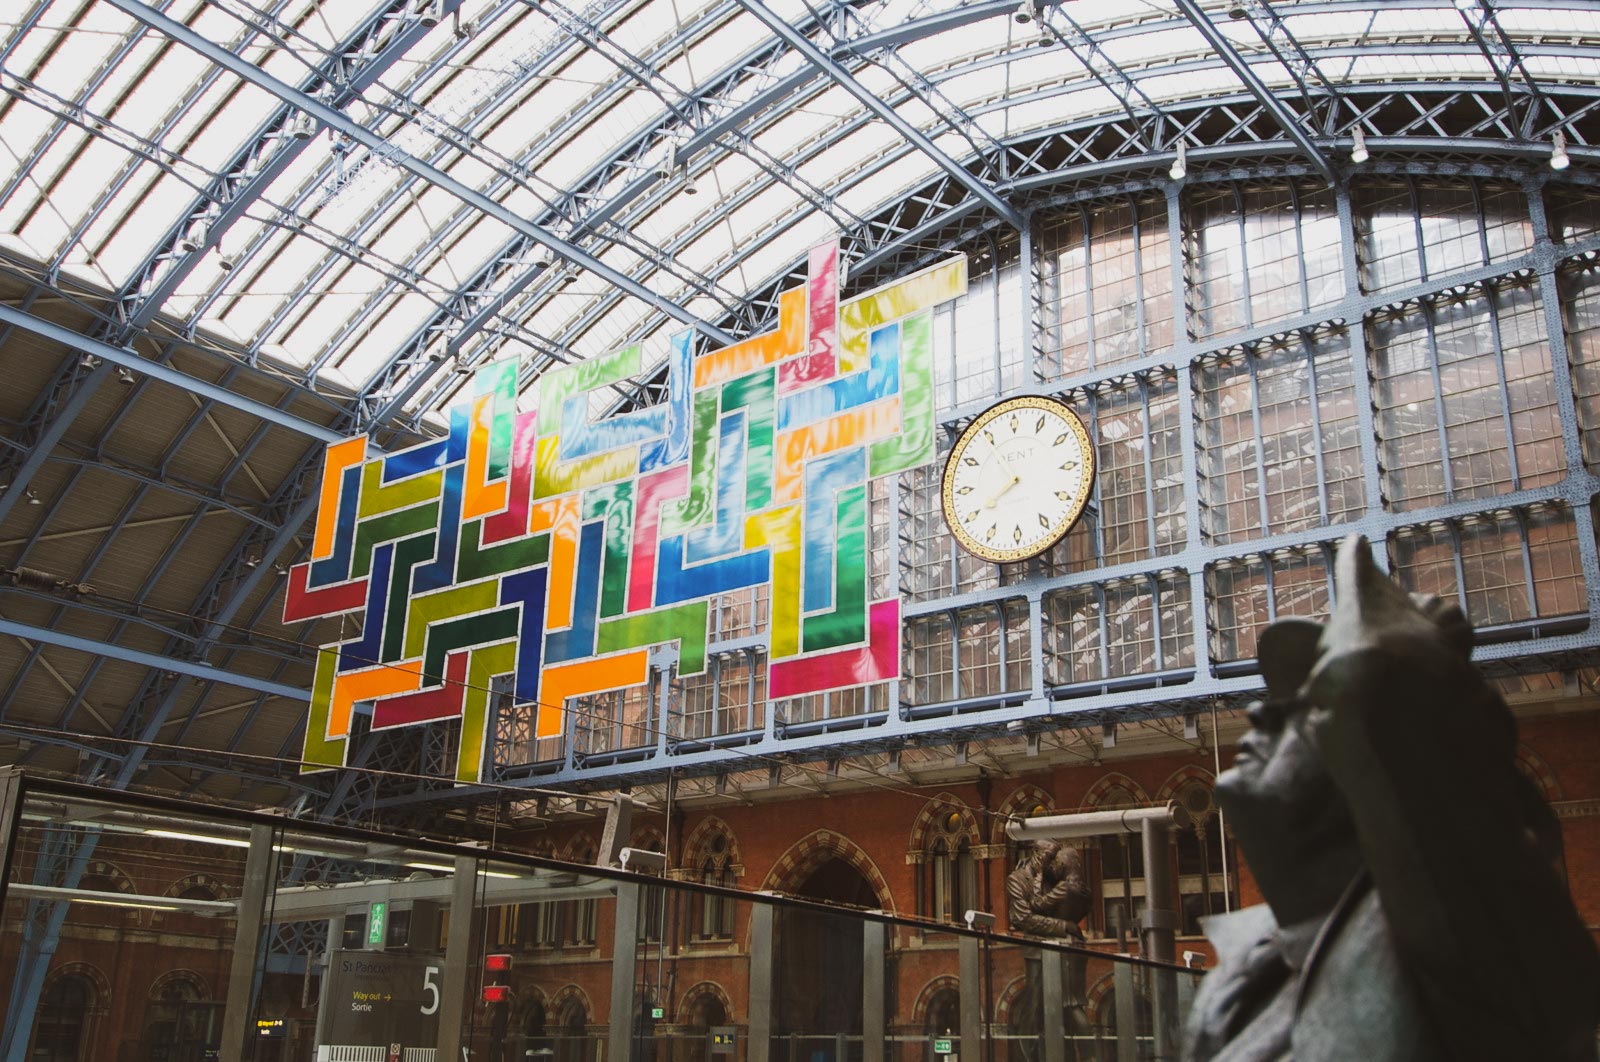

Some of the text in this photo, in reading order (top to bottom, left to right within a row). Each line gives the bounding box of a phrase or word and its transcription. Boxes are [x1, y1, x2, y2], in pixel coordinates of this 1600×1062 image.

[420, 966, 440, 1015] 5
[353, 992, 381, 1001] Way out
[351, 1003, 372, 1012] Sortie
